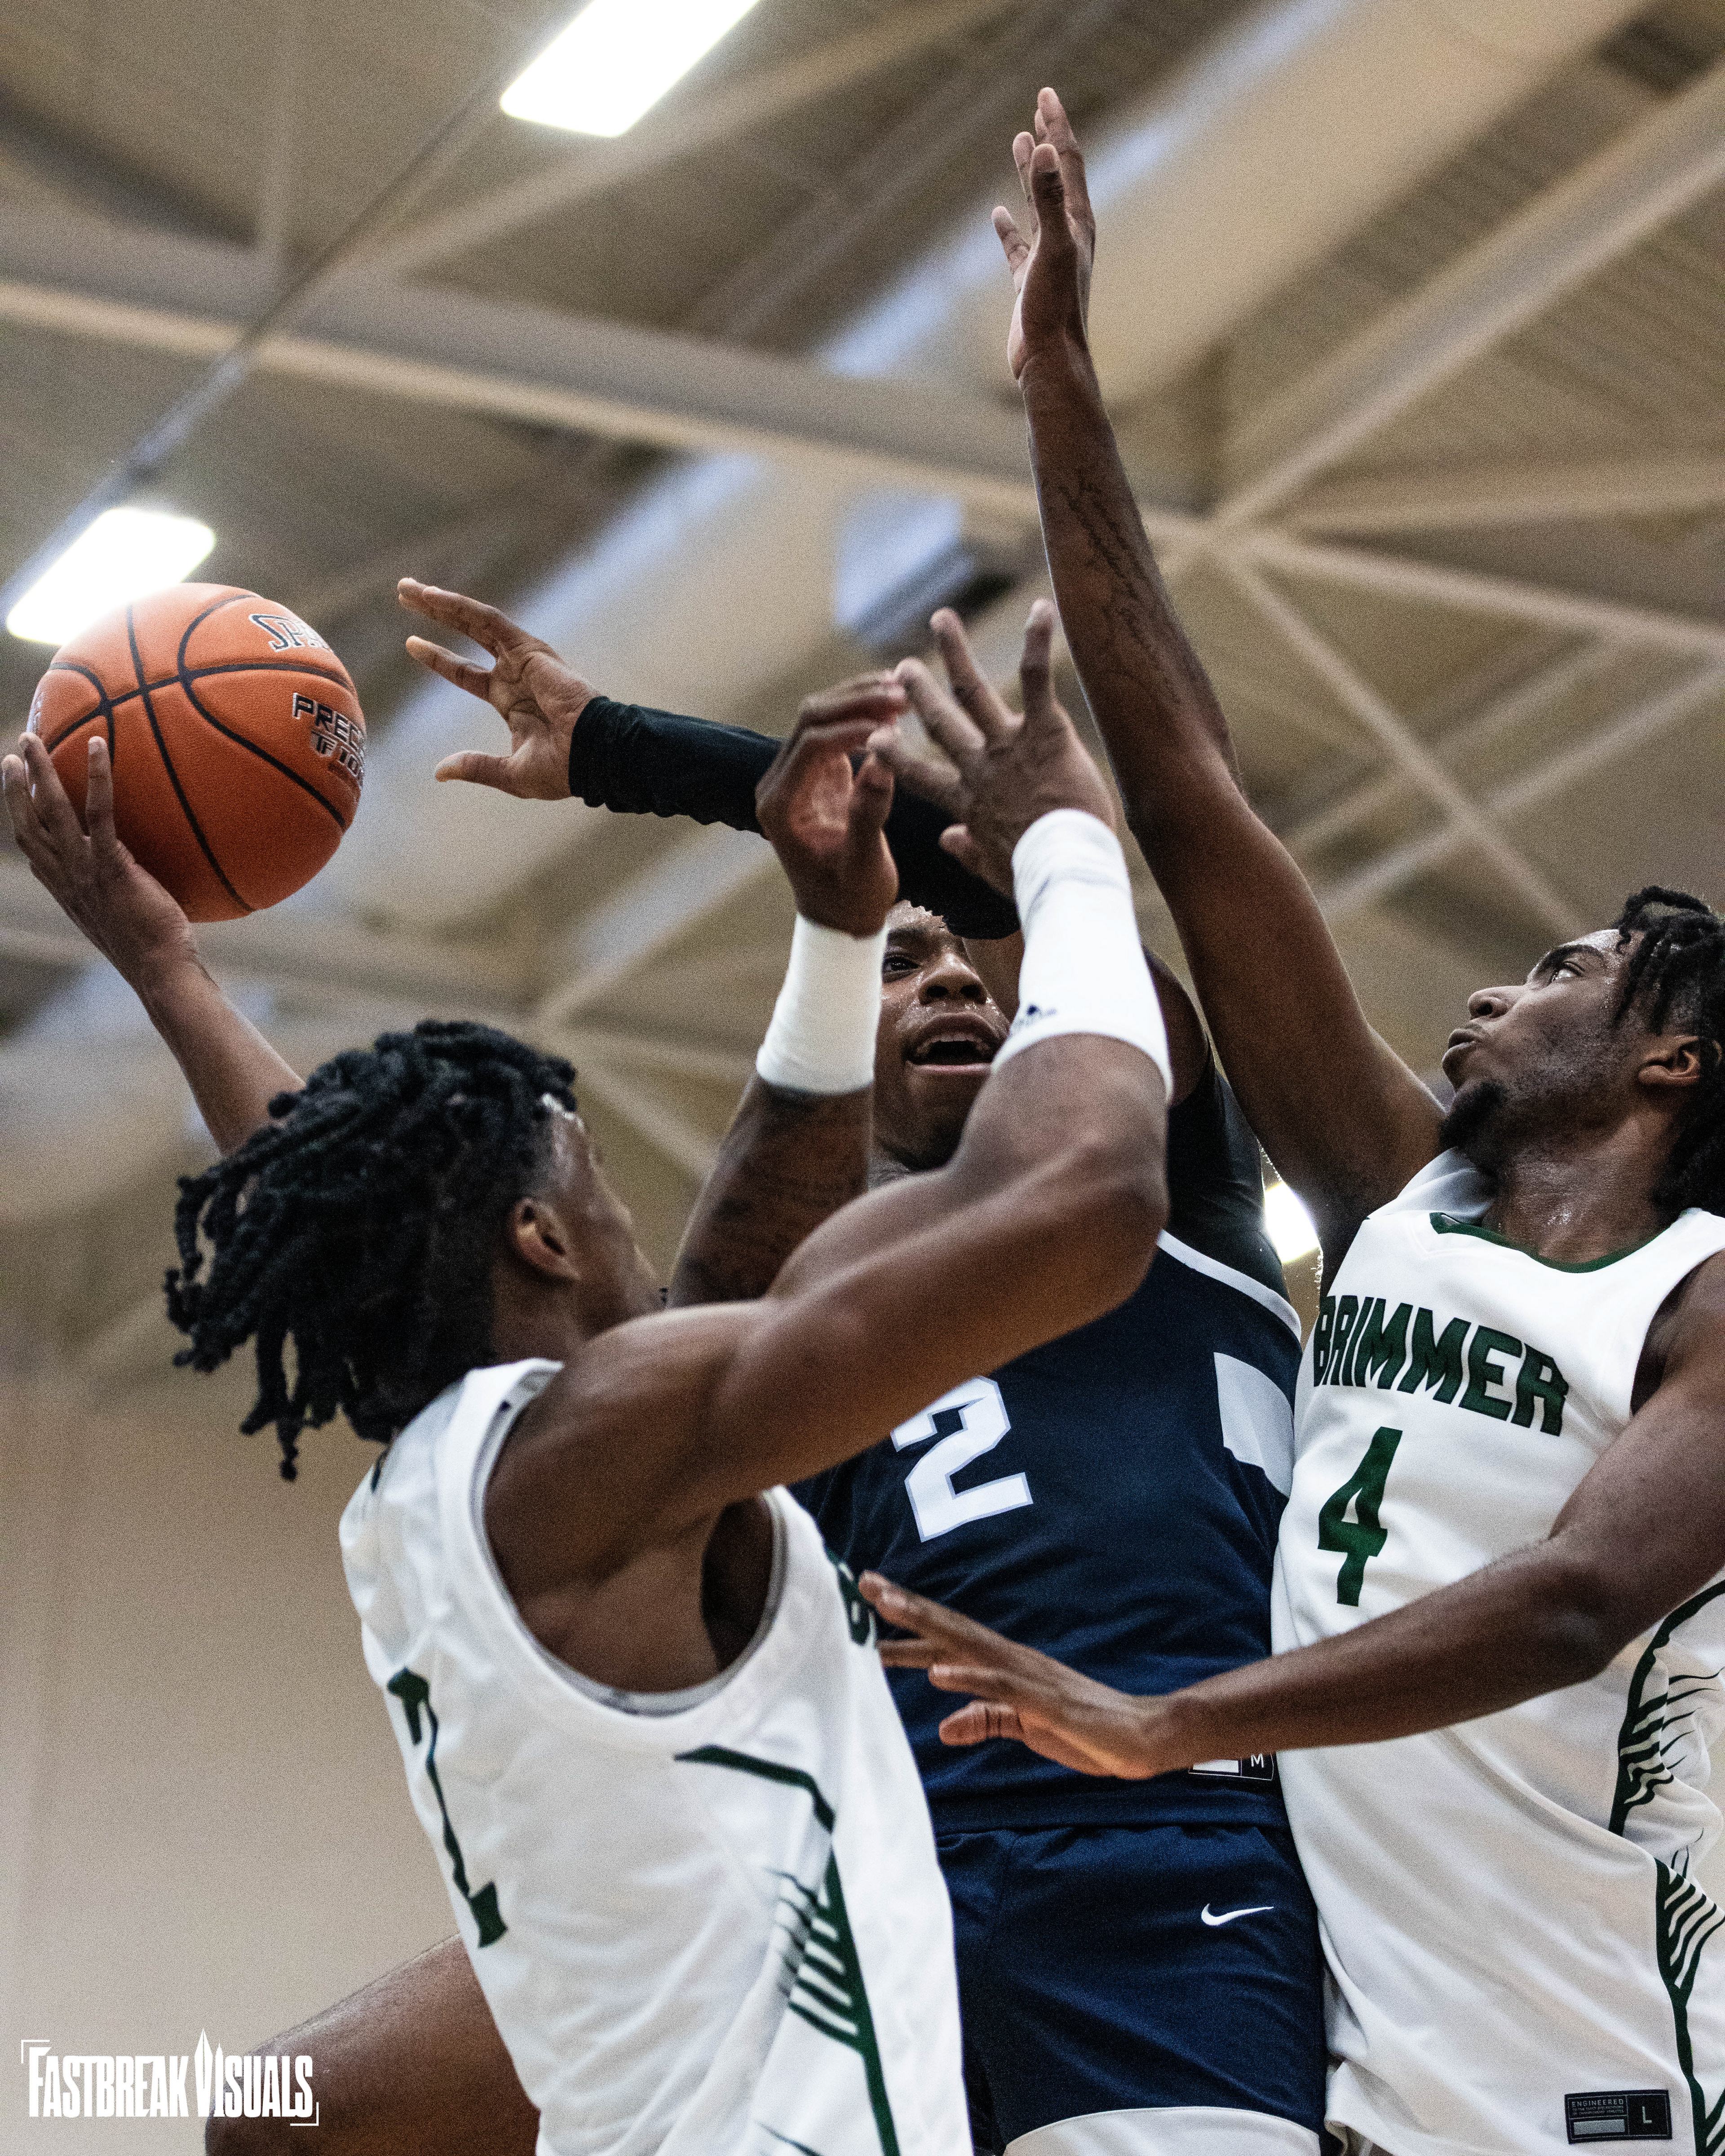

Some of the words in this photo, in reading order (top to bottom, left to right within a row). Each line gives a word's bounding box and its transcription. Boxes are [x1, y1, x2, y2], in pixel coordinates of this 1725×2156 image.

[1313, 1295, 1569, 1436] BRIMMER
[890, 1375, 1034, 1543] 2
[1318, 1426, 1403, 1607] 4
[1250, 1753, 1264, 1768] M
[1572, 2099, 1624, 2107] ENGINEERED
[1641, 2106, 1653, 2124] L
